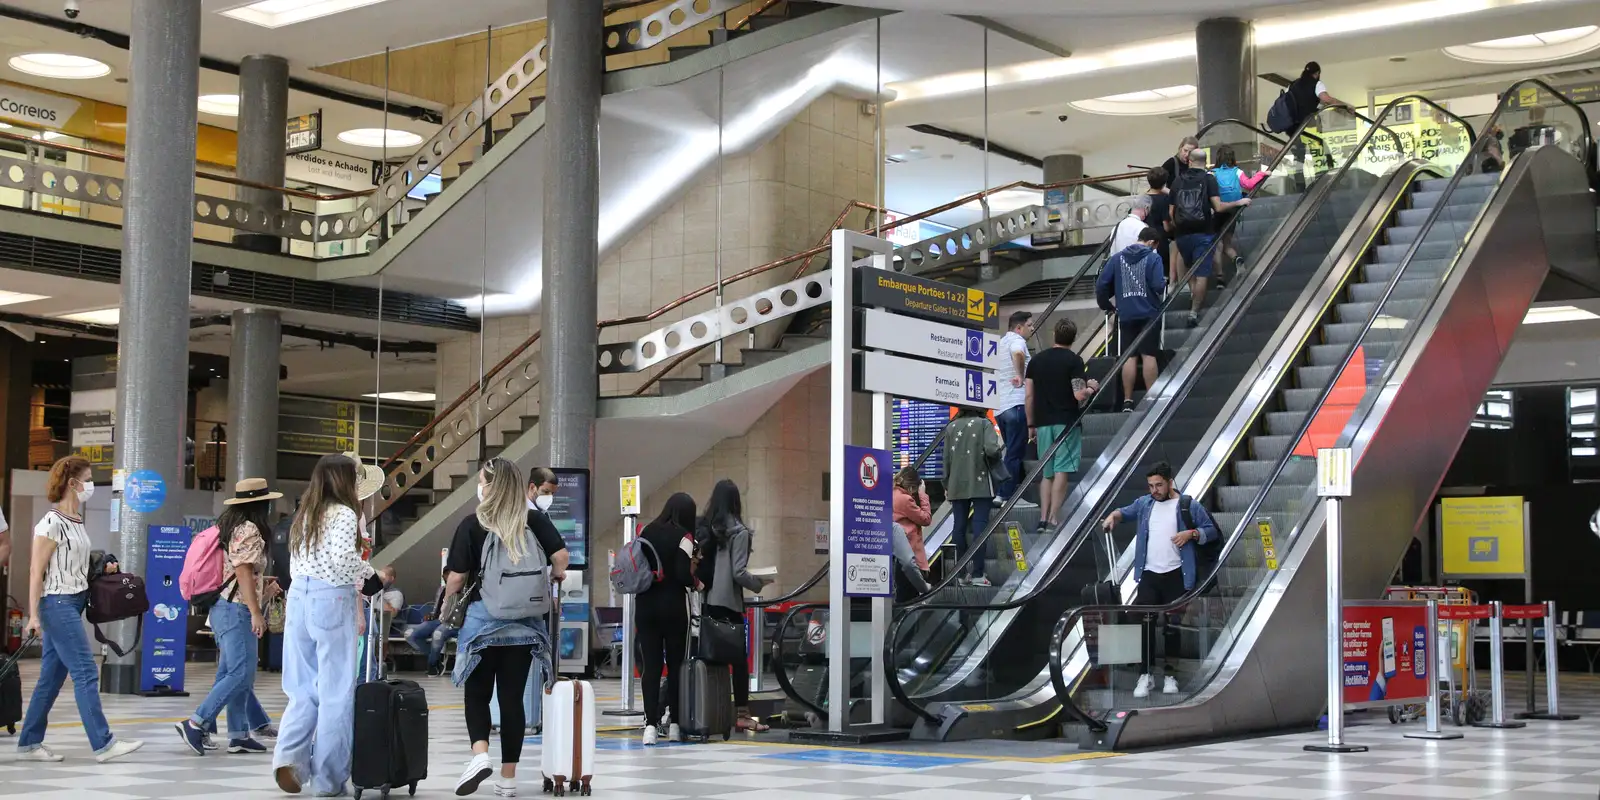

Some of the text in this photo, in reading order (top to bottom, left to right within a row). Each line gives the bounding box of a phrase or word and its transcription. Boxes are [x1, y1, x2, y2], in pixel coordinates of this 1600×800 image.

[0, 98, 56, 121] Correios
[335, 160, 368, 174] Achados
[878, 276, 917, 294] Embarque
[918, 284, 946, 300] Portões
[946, 291, 950, 300] 1
[957, 293, 965, 303] 22
[905, 297, 932, 311] Departure
[932, 304, 948, 314] Gates
[952, 307, 958, 315] to
[958, 308, 966, 318] 22
[931, 333, 963, 346] Restaurante
[938, 348, 963, 360] Restaurant
[935, 388, 960, 401] Drugstore
[1343, 620, 1371, 630] Quer aprender
[1352, 648, 1368, 657] milhas?
